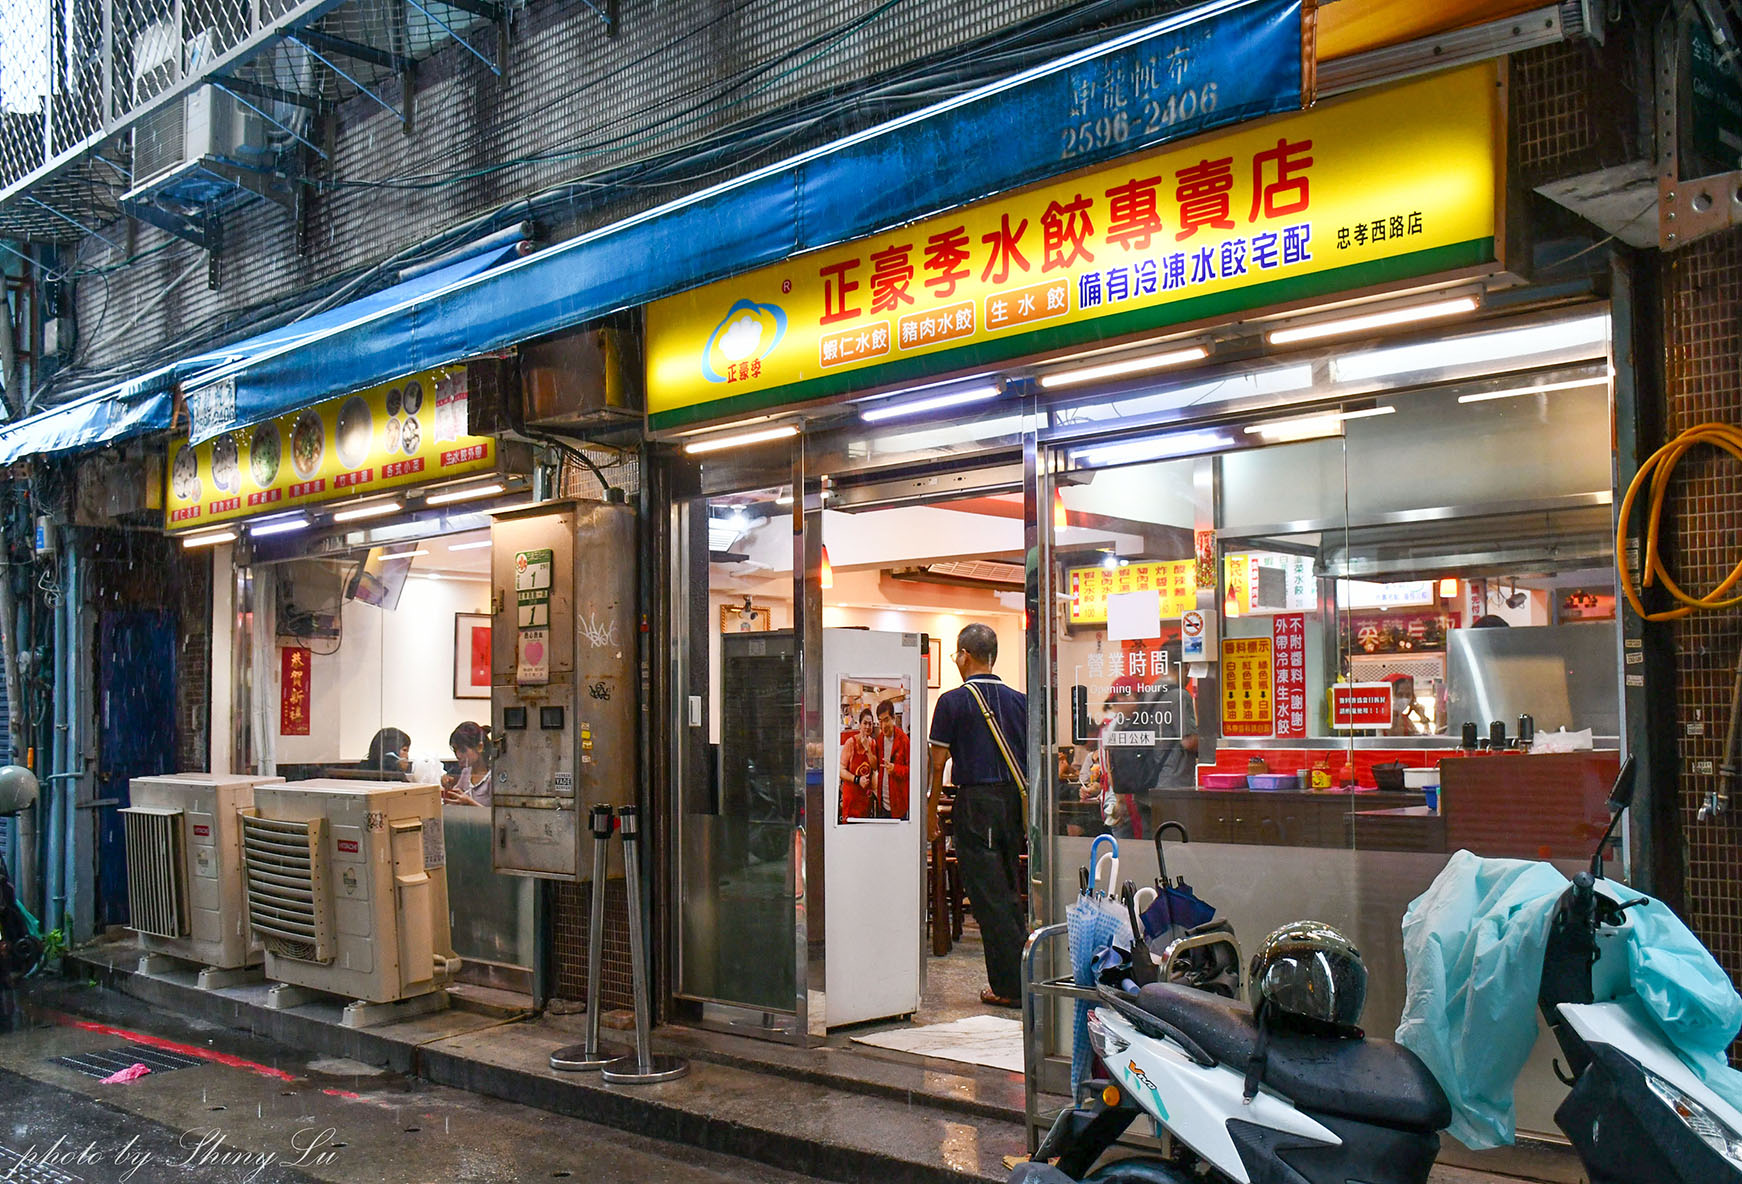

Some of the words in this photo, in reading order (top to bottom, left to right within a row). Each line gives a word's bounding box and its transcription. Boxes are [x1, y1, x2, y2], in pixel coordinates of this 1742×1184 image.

[1060, 82, 1218, 160] 2596-2406
[819, 138, 1314, 326] 正豪季水餃專賣店
[1336, 211, 1423, 250] 忠孝西路店
[1078, 224, 1312, 309] 備有冷凍水餃宅配
[822, 328, 887, 361] 蝦仁水餃
[902, 308, 973, 344] 豬肉水餃
[727, 358, 761, 384] 正豪季
[1087, 650, 1169, 678] 營業時間
[1137, 682, 1169, 693] Hours
[1275, 618, 1290, 735] 外帶冷凍生水餃
